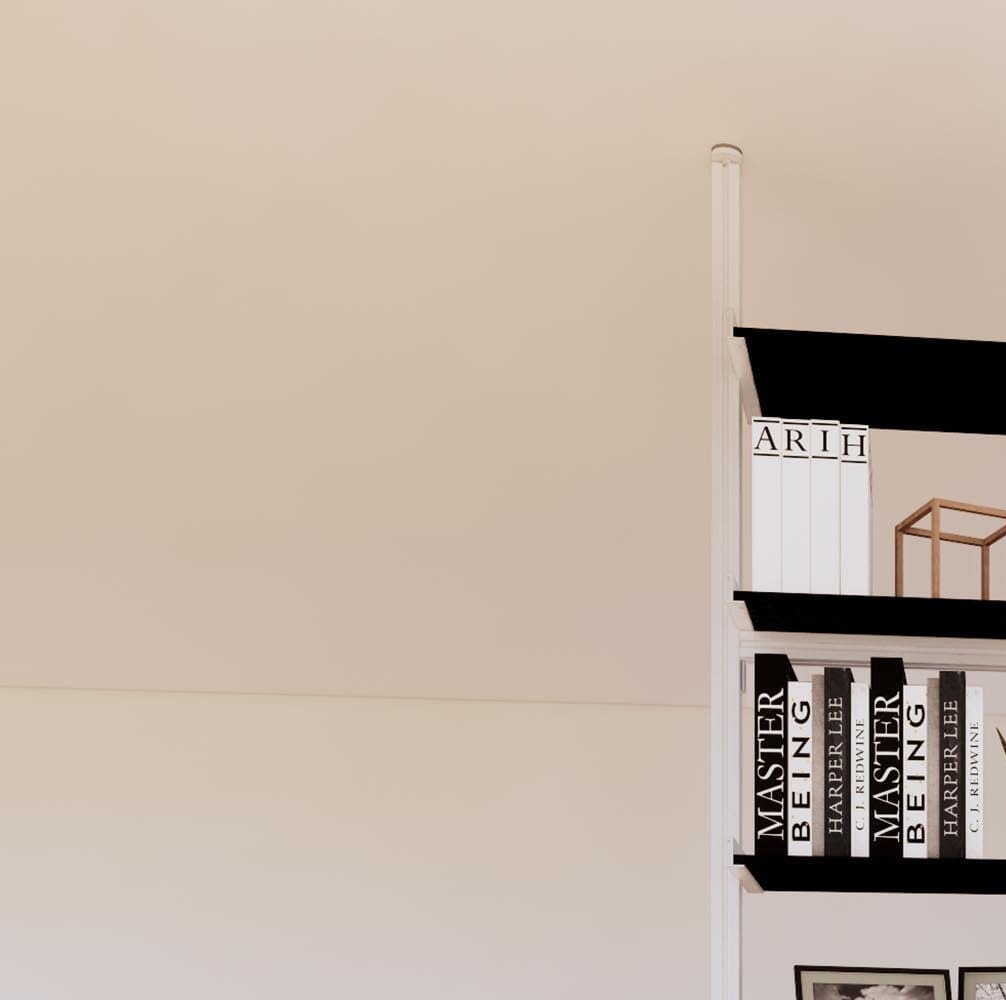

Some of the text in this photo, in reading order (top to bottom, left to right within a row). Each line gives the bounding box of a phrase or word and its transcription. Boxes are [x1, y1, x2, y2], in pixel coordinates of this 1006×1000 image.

[754, 426, 778, 450] A
[785, 428, 807, 452] R
[821, 430, 830, 452] I
[842, 434, 866, 456] H
[757, 688, 784, 840] MASTER
[792, 701, 811, 842] BEING
[828, 697, 844, 834] HARPER LEE
[856, 719, 864, 794] REDWINE
[872, 692, 900, 843] MASTER
[906, 704, 926, 844] BEING
[944, 700, 959, 836] HARPER LEE
[970, 722, 979, 796] REDWINE
